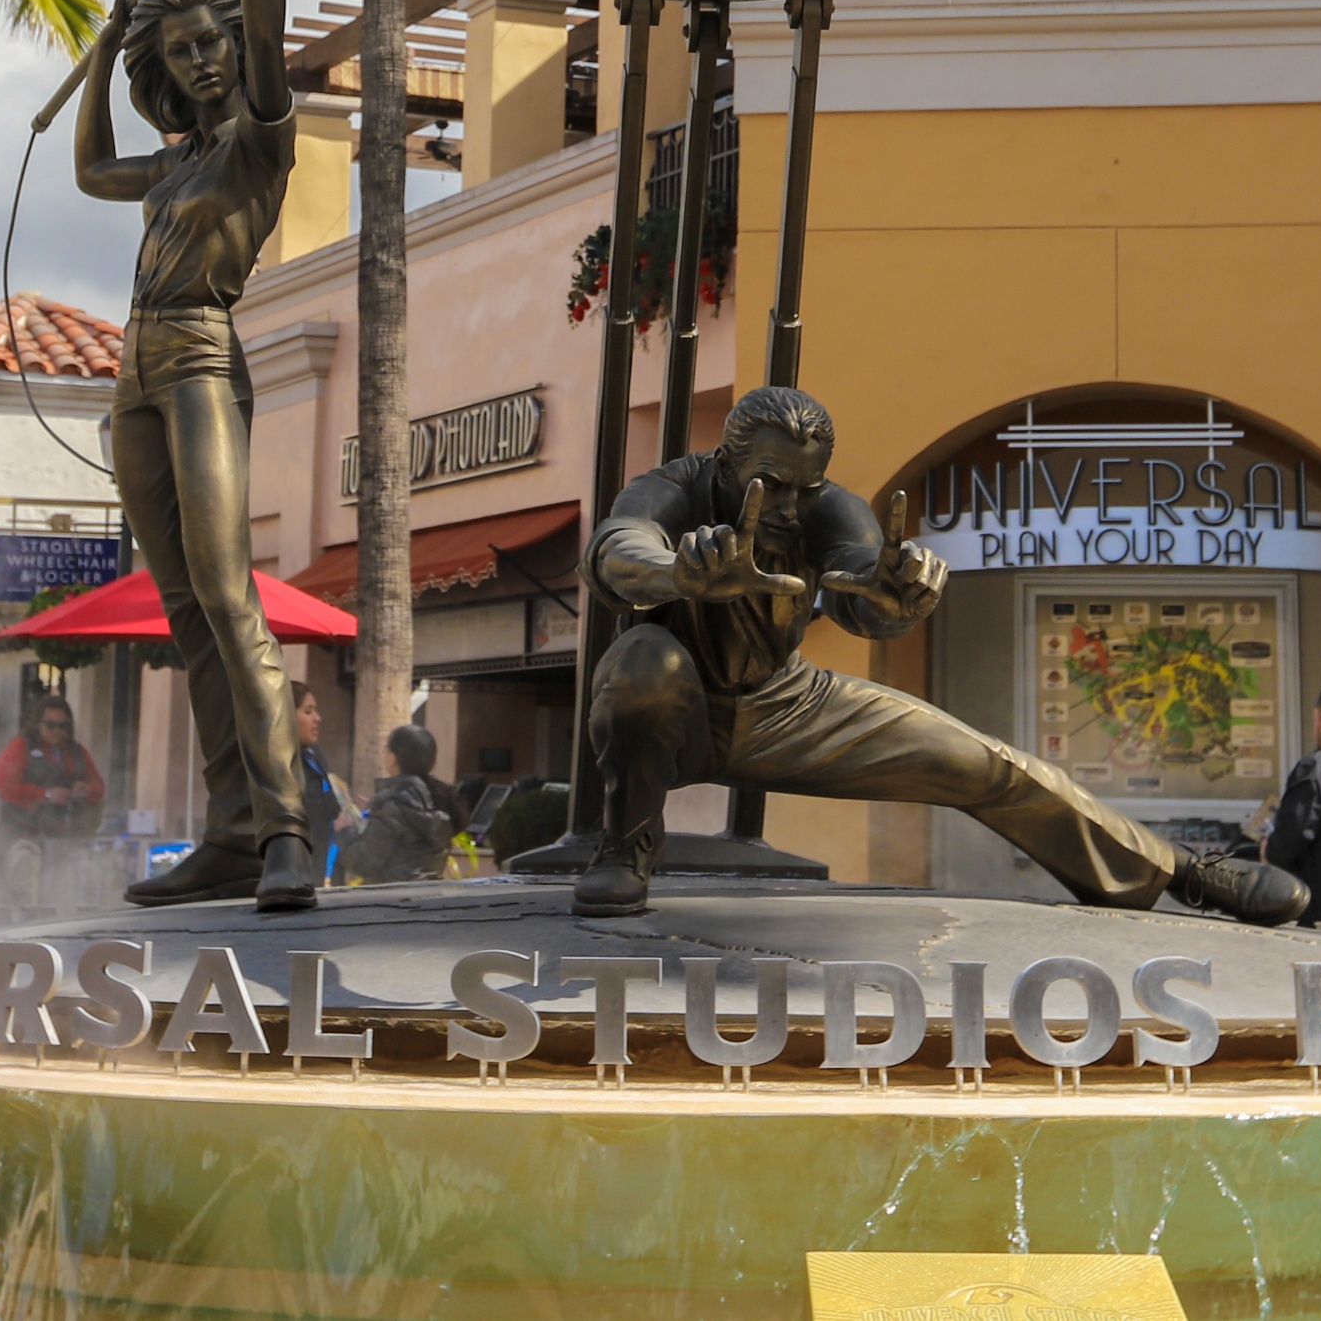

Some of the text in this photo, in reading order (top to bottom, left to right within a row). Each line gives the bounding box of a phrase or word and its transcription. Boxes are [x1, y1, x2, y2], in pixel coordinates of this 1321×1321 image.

[435, 395, 542, 475] PHOTOLAND
[21, 540, 103, 555] STROLLER
[981, 527, 1263, 567] PLAN YOUR DAY
[7, 555, 116, 570] WHEELCHAIR
[36, 569, 103, 585] LOCKER
[447, 949, 1220, 1068] STUDIOS
